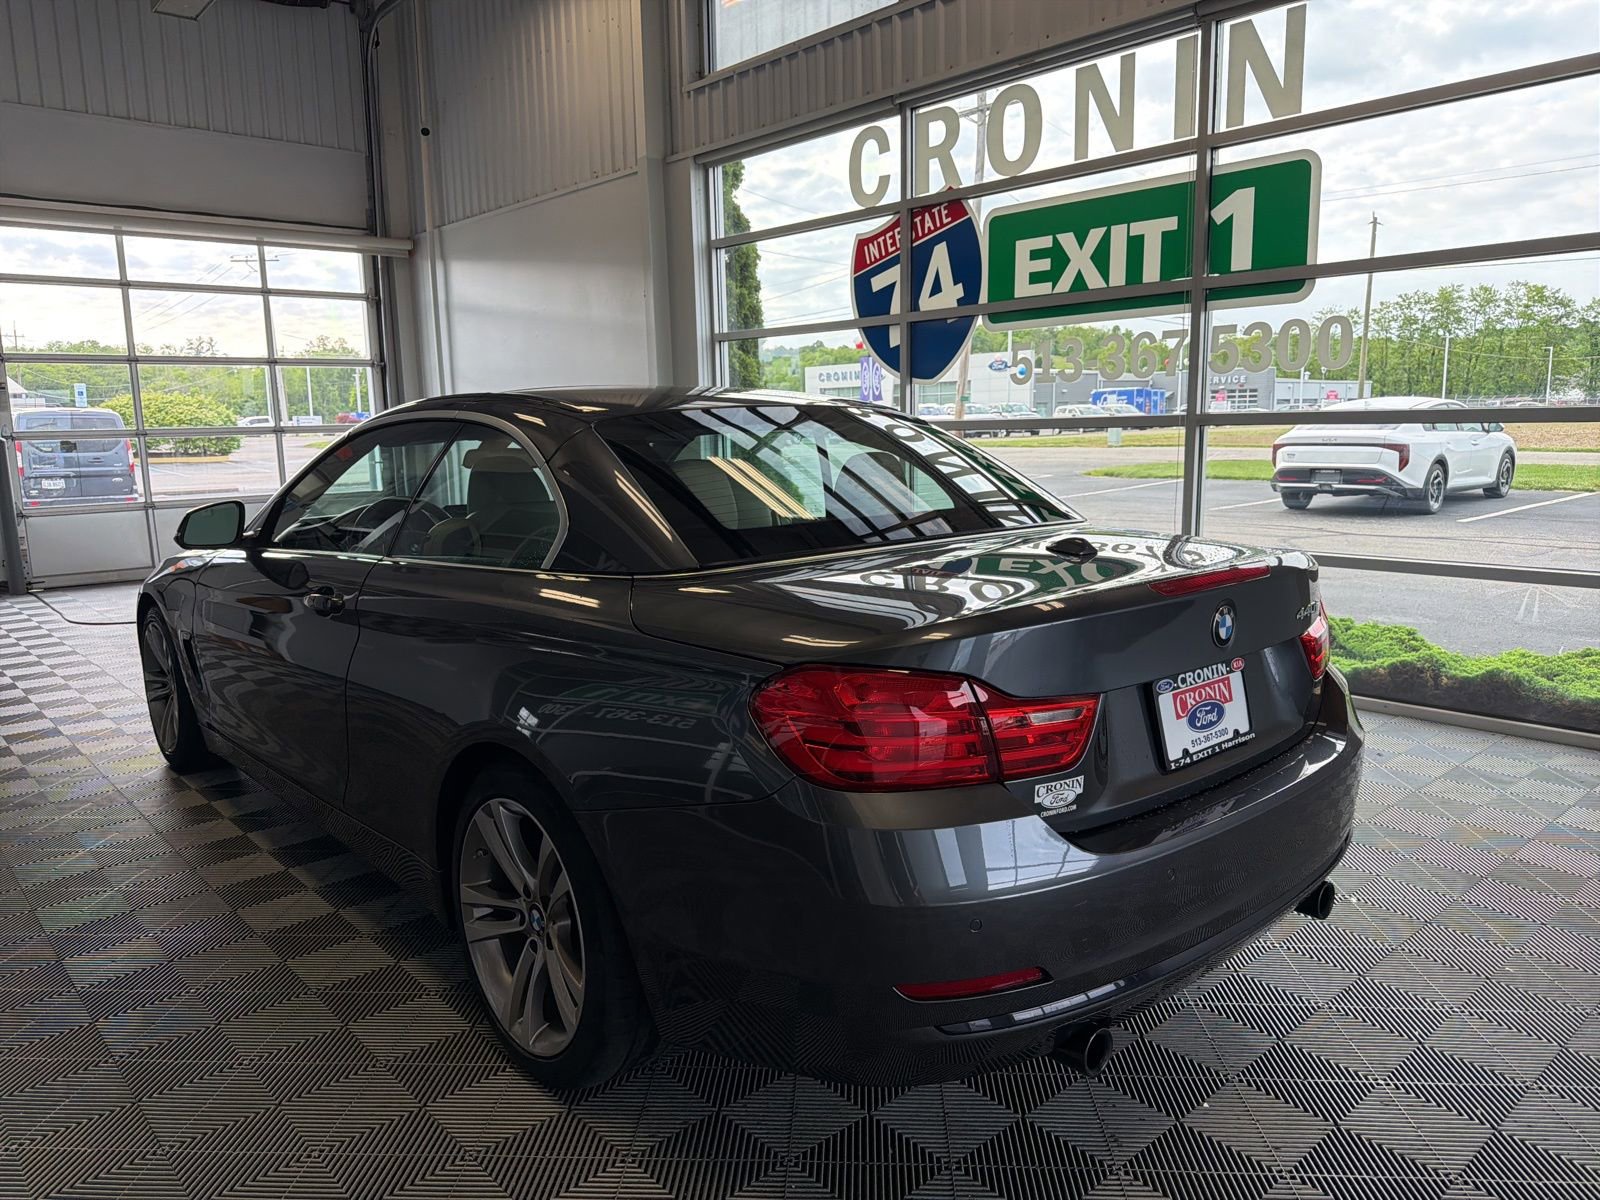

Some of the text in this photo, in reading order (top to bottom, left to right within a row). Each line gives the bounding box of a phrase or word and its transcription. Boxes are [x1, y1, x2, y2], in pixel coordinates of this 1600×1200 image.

[848, 5, 1307, 208] CRONIN
[1013, 186, 1256, 299] EXIT 1
[870, 240, 965, 349] 74
[1009, 315, 1354, 386] 513-3675300
[818, 371, 861, 383] CRONIN
[1177, 660, 1243, 688] CRONIN KIA
[1175, 680, 1231, 717] CRONIN
[1195, 706, 1218, 727] Ford
[1170, 757, 1191, 770] I-74
[1192, 749, 1213, 760] EXIT
[1221, 732, 1256, 750] Harrison
[1190, 727, 1229, 748] 513-367-5300
[1036, 777, 1083, 798] CRONIN
[1050, 792, 1070, 806] Ford
